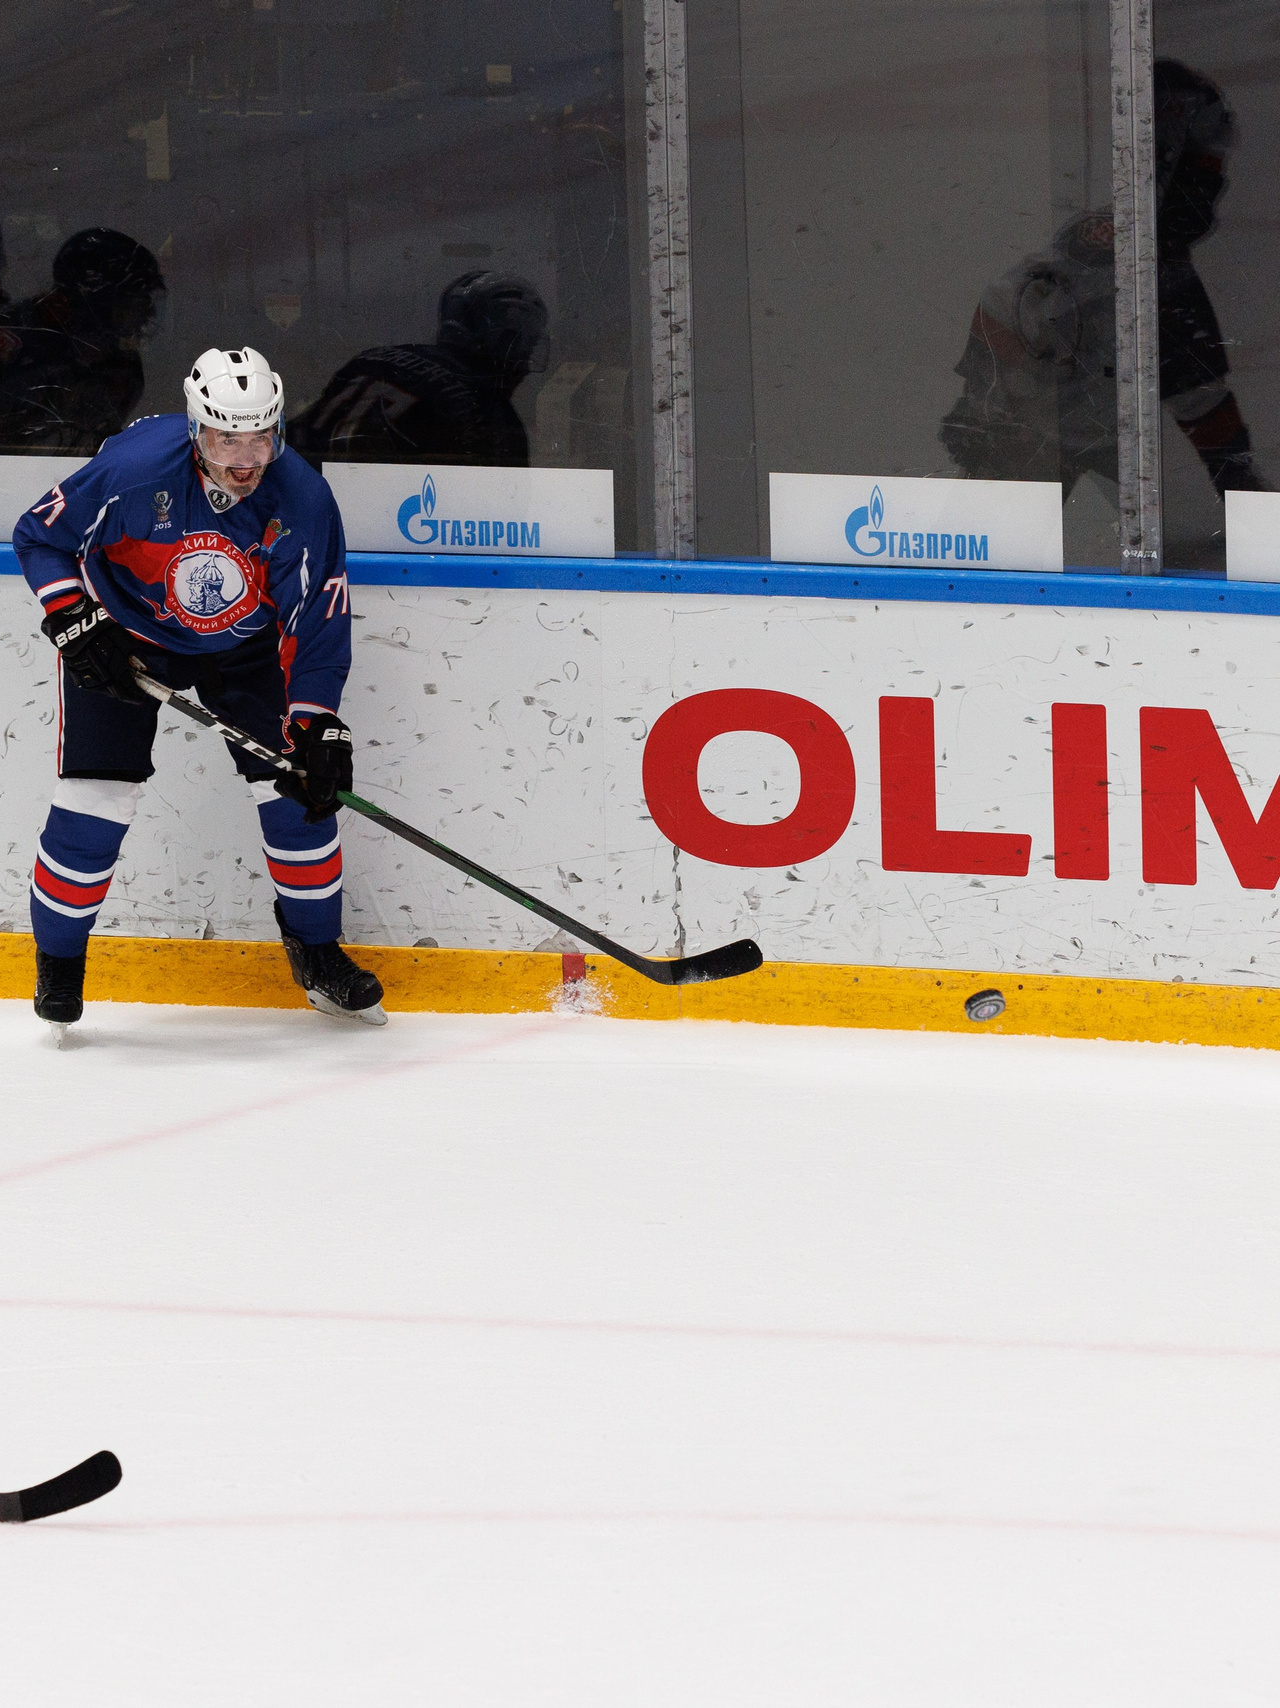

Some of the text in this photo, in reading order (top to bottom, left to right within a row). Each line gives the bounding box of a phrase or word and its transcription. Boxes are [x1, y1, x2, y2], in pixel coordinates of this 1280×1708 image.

[231, 413, 261, 422] Reebok
[32, 484, 67, 528] 71
[153, 520, 173, 532] 2015
[440, 519, 541, 549] ГАЗПРОМ
[888, 531, 989, 562] ГАЗПРОМ
[323, 570, 348, 620] 71
[54, 607, 110, 648] BAUE
[223, 605, 248, 624] КЛУБ
